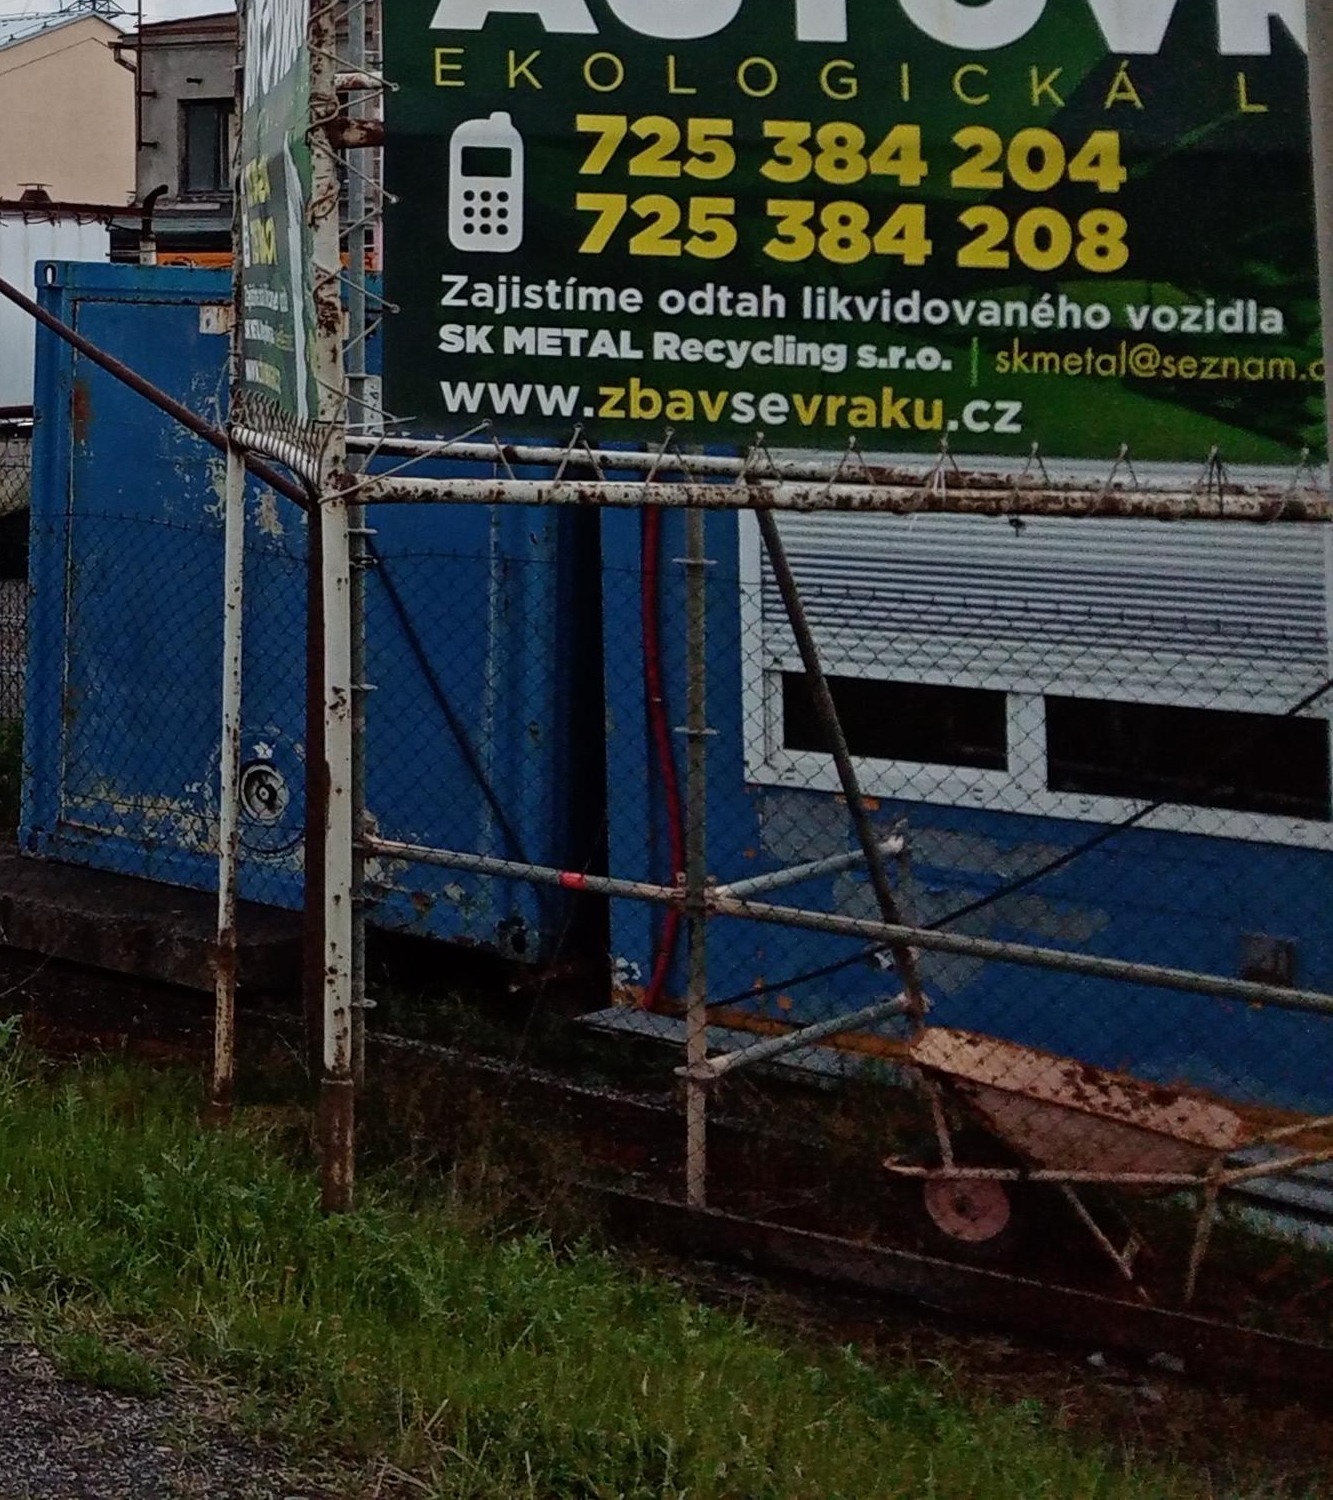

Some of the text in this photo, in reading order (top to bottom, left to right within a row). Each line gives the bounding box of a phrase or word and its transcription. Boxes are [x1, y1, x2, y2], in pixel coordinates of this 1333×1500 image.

[434, 47, 1144, 110] EKOLOGICKÁ
[576, 113, 1128, 193] 725 384 204
[576, 191, 1130, 273] 725 384 208
[440, 274, 1284, 334] Zajistíme odtah likvidovaného vozidla
[438, 323, 953, 373] SK METAL Recycling s.r.o.
[439, 377, 1023, 435] www.zbavsevraku.cz
